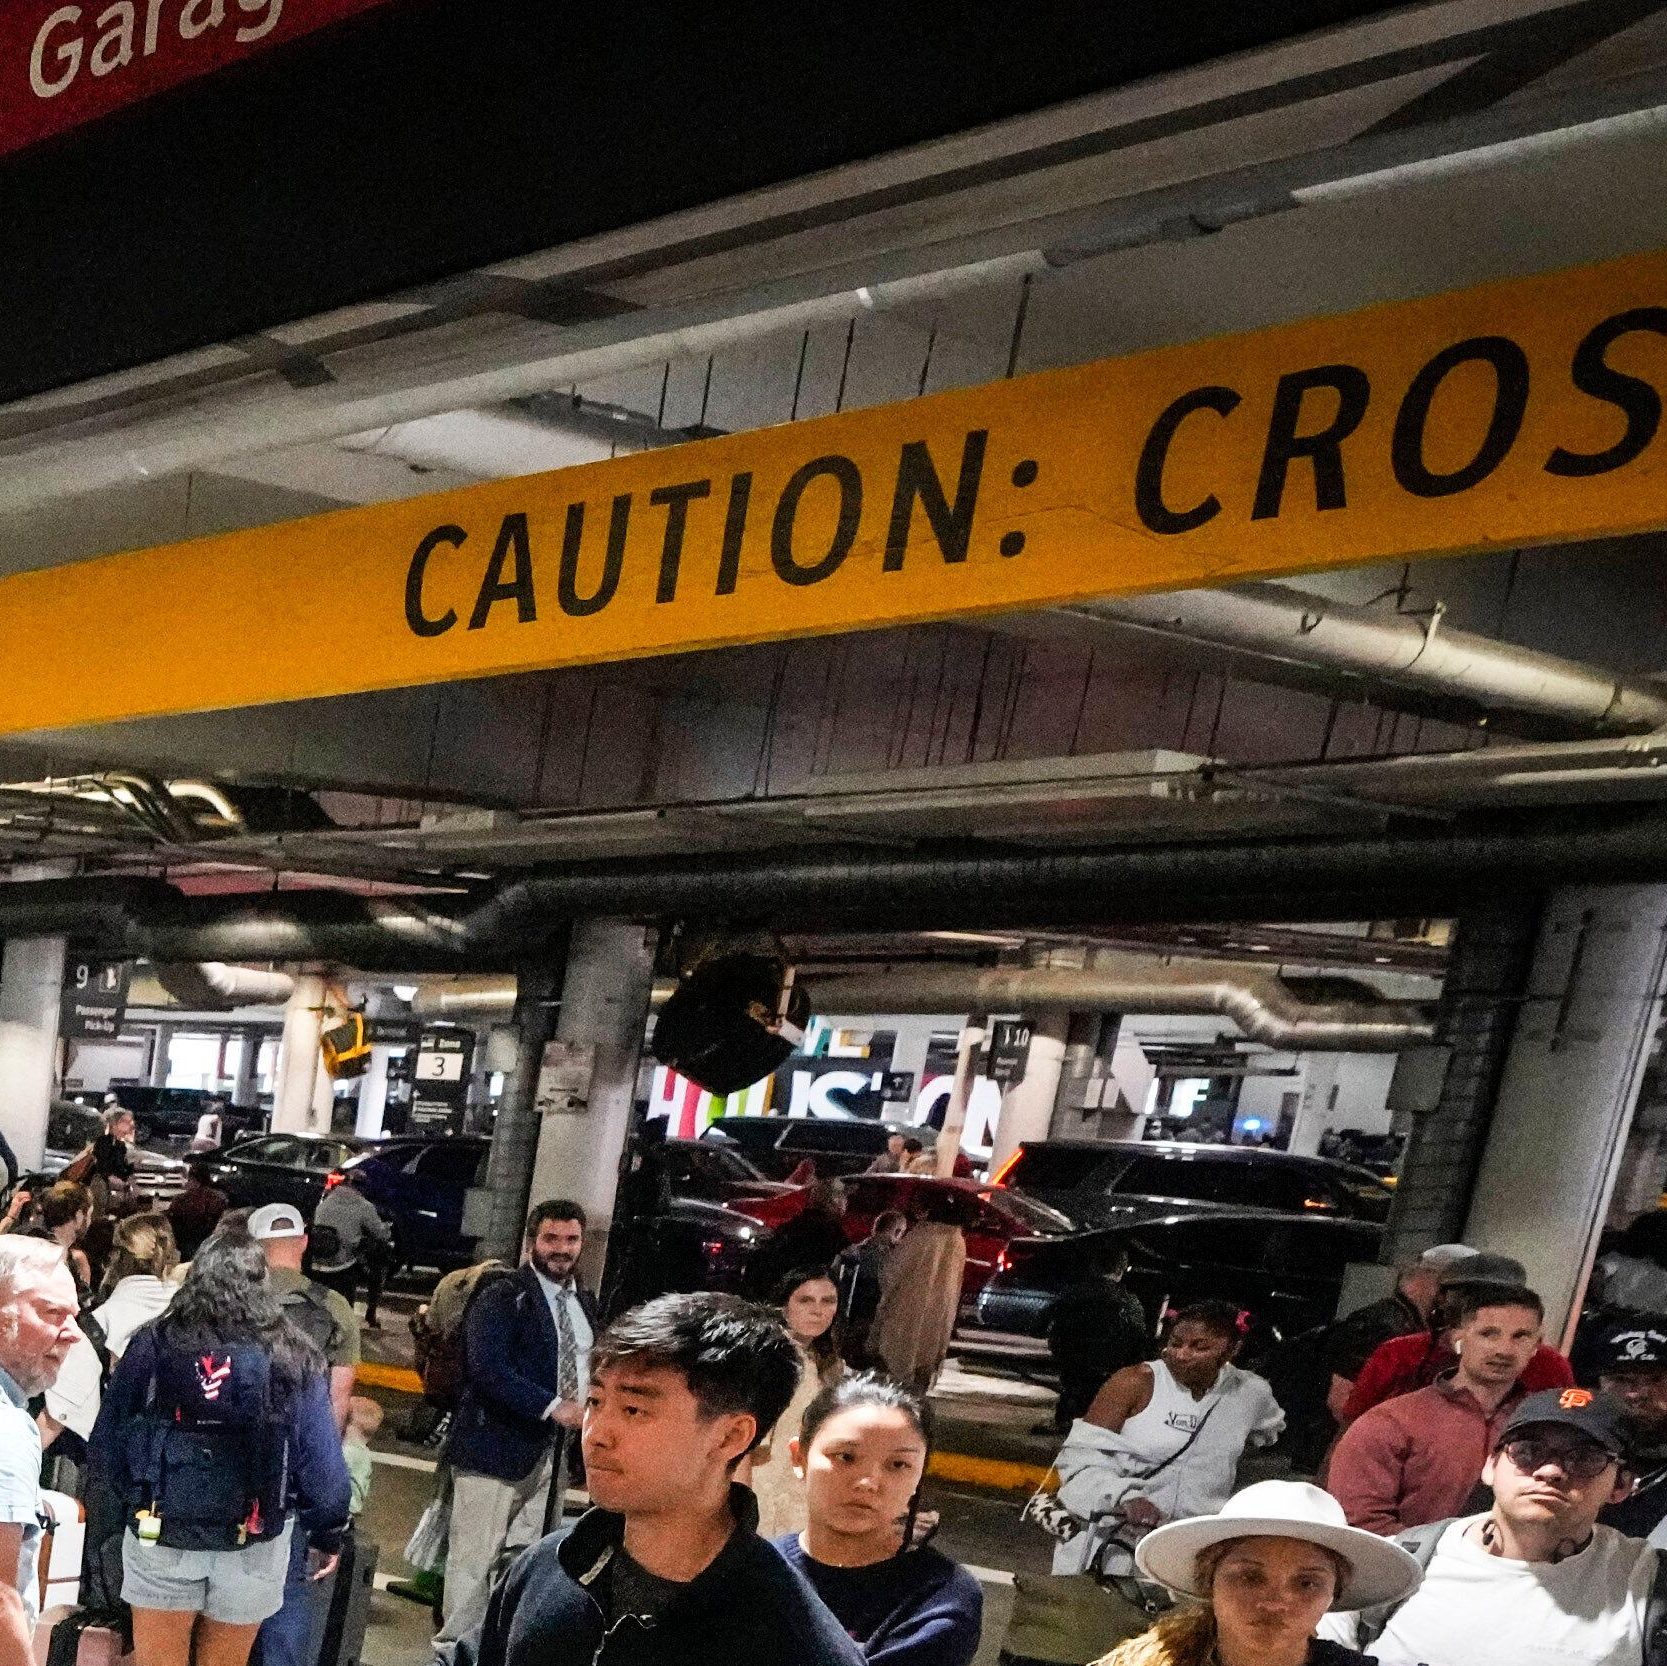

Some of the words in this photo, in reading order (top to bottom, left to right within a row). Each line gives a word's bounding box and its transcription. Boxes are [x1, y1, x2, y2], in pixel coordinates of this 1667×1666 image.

[403, 429, 1043, 638] CAUTION:
[1132, 305, 1667, 536] CROS
[76, 964, 89, 990] 9
[431, 1056, 446, 1077] 3
